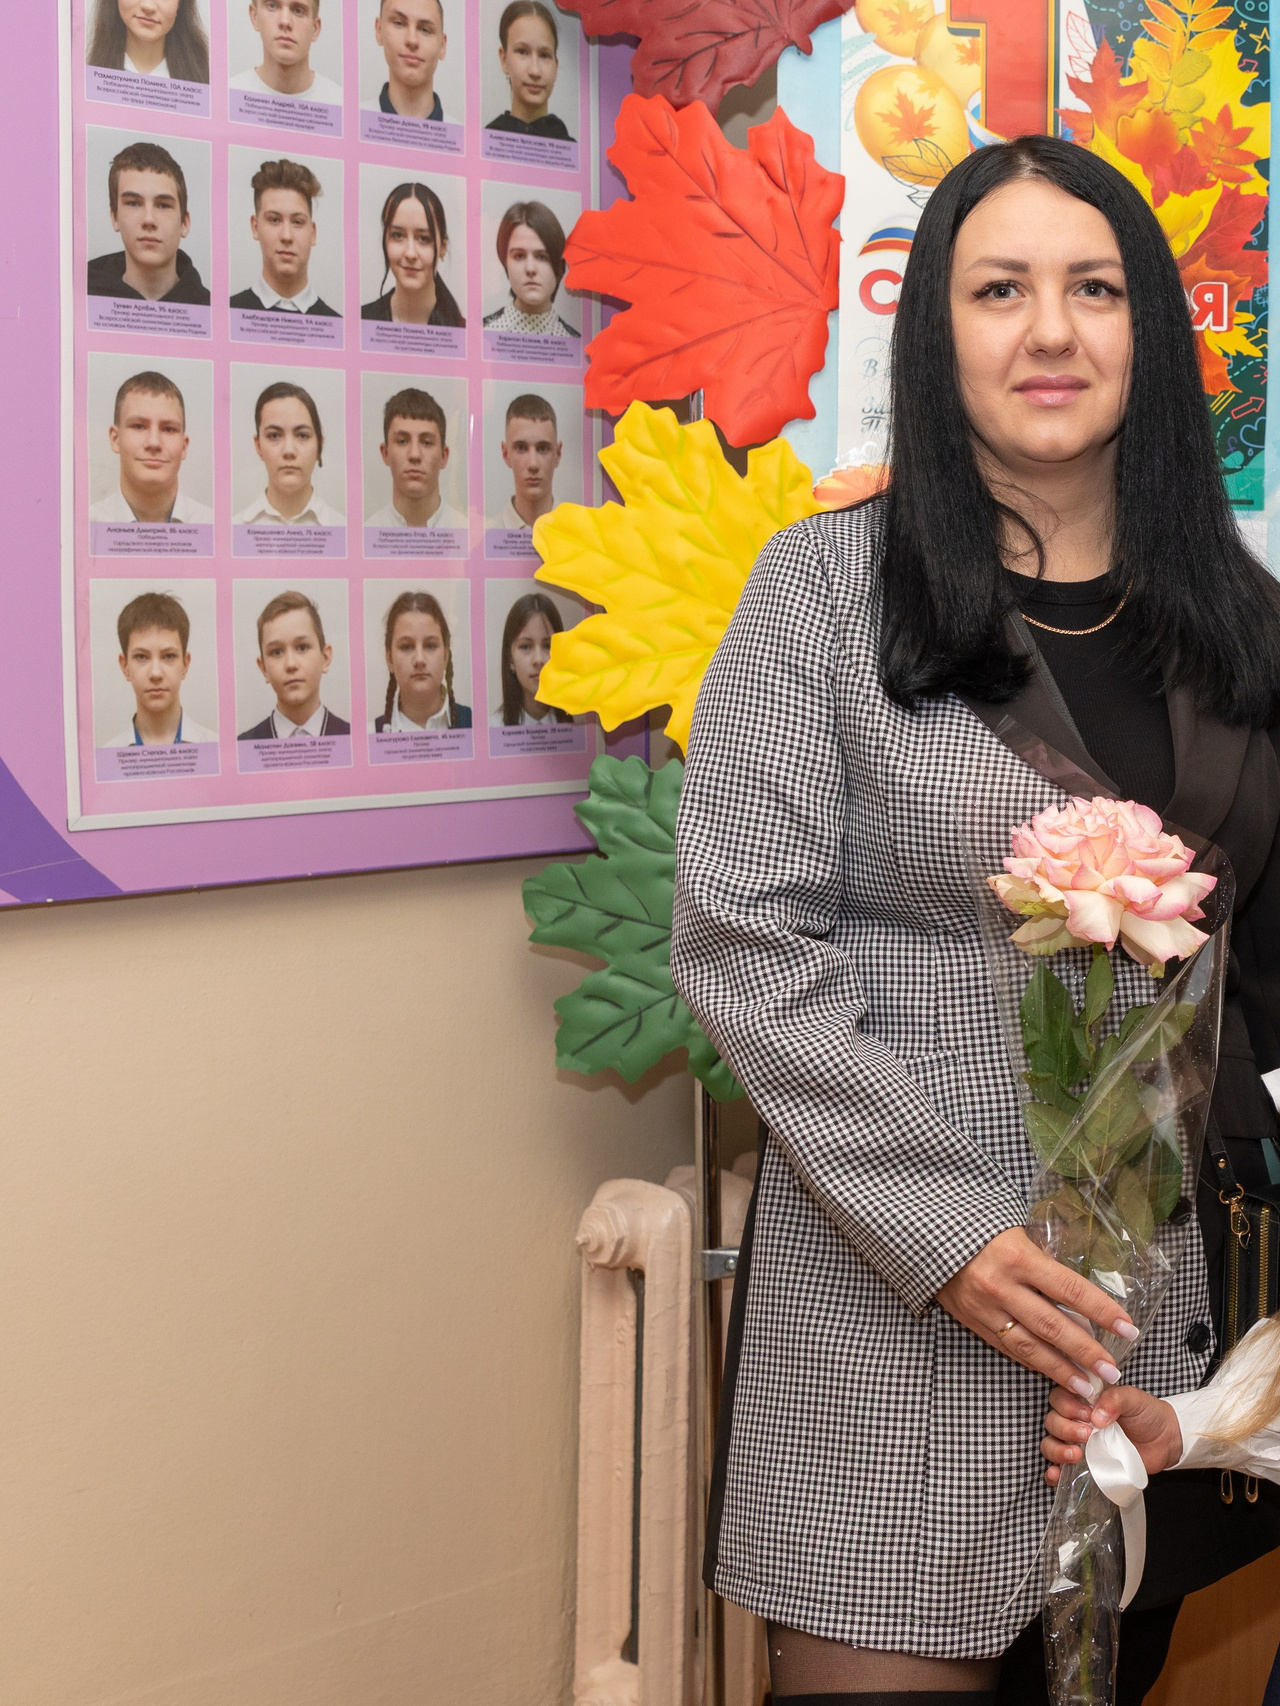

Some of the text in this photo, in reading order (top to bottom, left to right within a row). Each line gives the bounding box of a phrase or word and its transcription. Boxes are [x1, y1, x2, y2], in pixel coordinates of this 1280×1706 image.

[93, 70, 139, 83] Рахматулина
[140, 78, 167, 88] Полина,
[182, 85, 202, 93] класс
